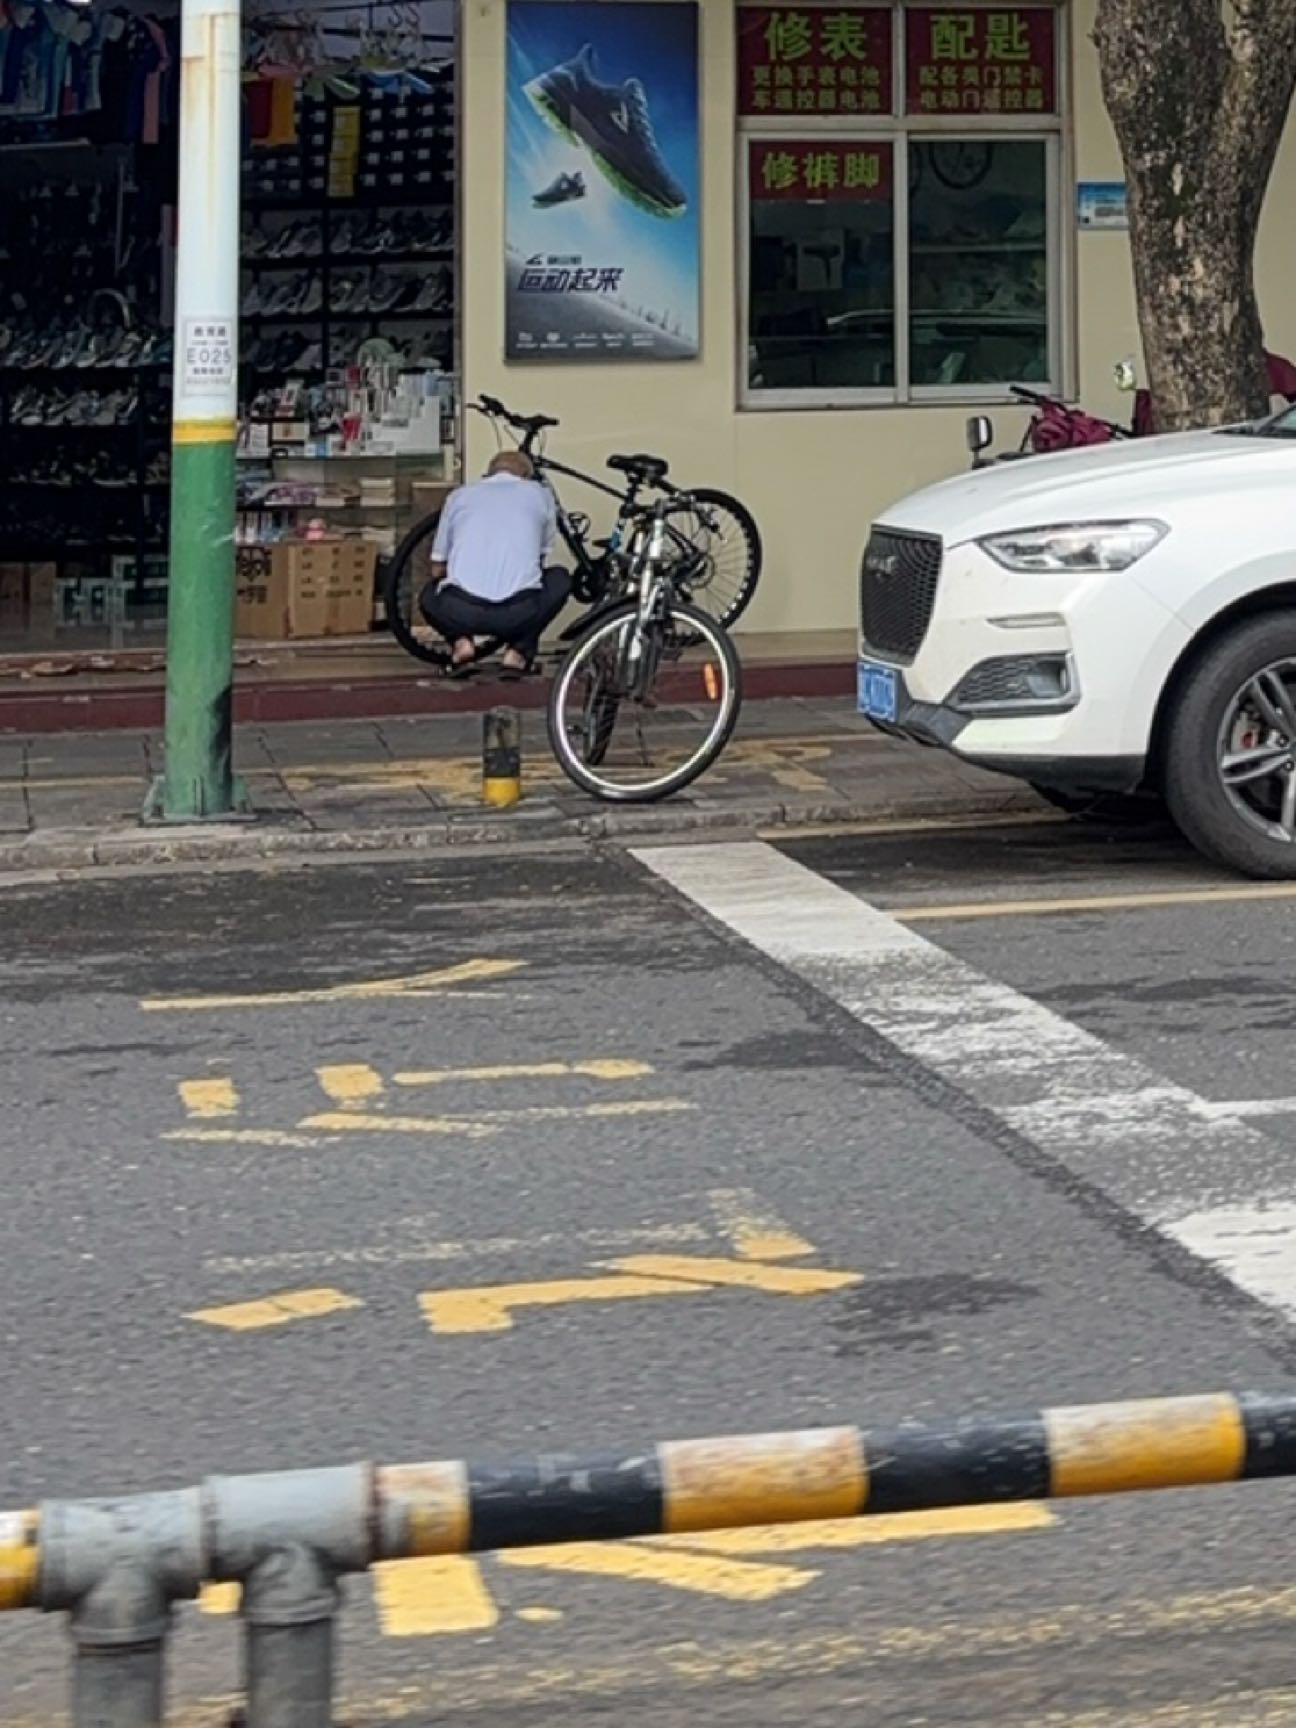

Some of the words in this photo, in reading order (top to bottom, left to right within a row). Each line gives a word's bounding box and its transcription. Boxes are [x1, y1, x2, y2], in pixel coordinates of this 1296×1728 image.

[763, 12, 868, 61] 修表
[929, 13, 1032, 61] 配匙
[762, 152, 880, 189] 修裤脚
